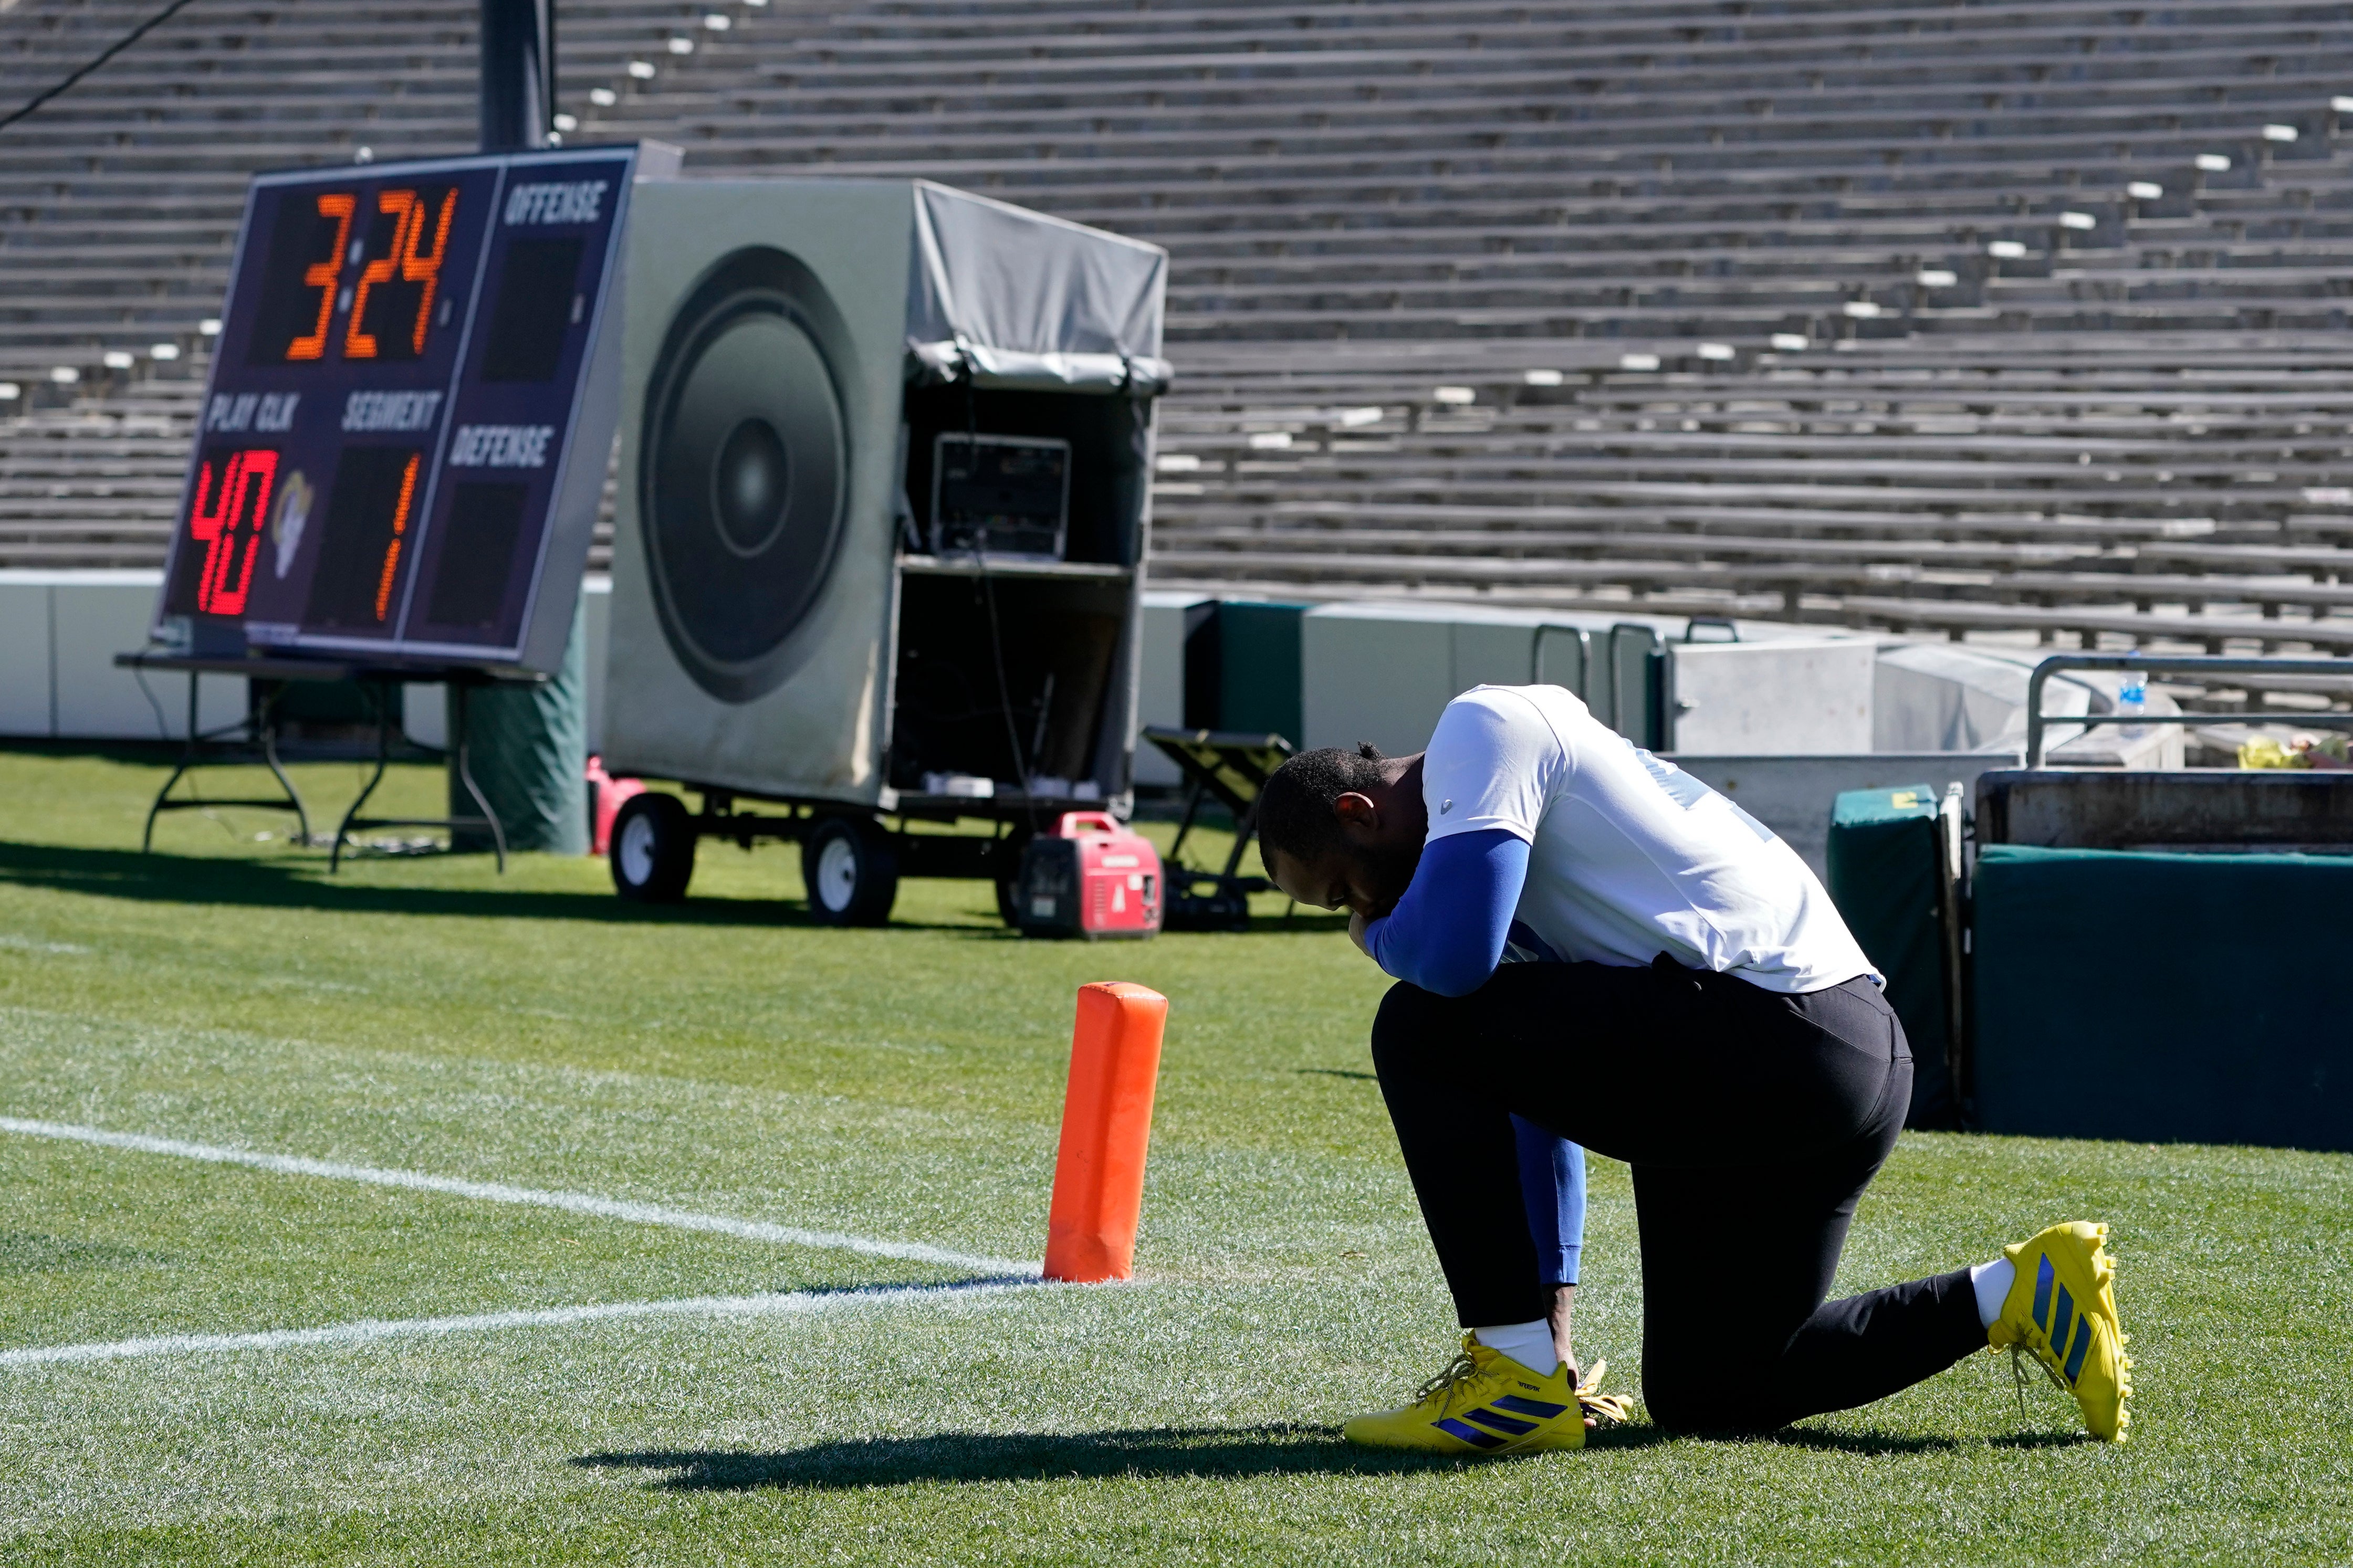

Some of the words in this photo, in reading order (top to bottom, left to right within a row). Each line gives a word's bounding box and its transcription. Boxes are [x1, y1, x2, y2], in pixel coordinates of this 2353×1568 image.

[504, 180, 609, 225] OFFENSE
[285, 188, 459, 360] 3:24
[206, 392, 260, 432] PLAY
[256, 392, 301, 432] CLK
[341, 390, 443, 432] SEGMENT
[449, 424, 555, 467] DEFENSE
[191, 450, 279, 615] 40
[375, 453, 421, 621] 1
[1517, 1380, 1541, 1392] FREAK
